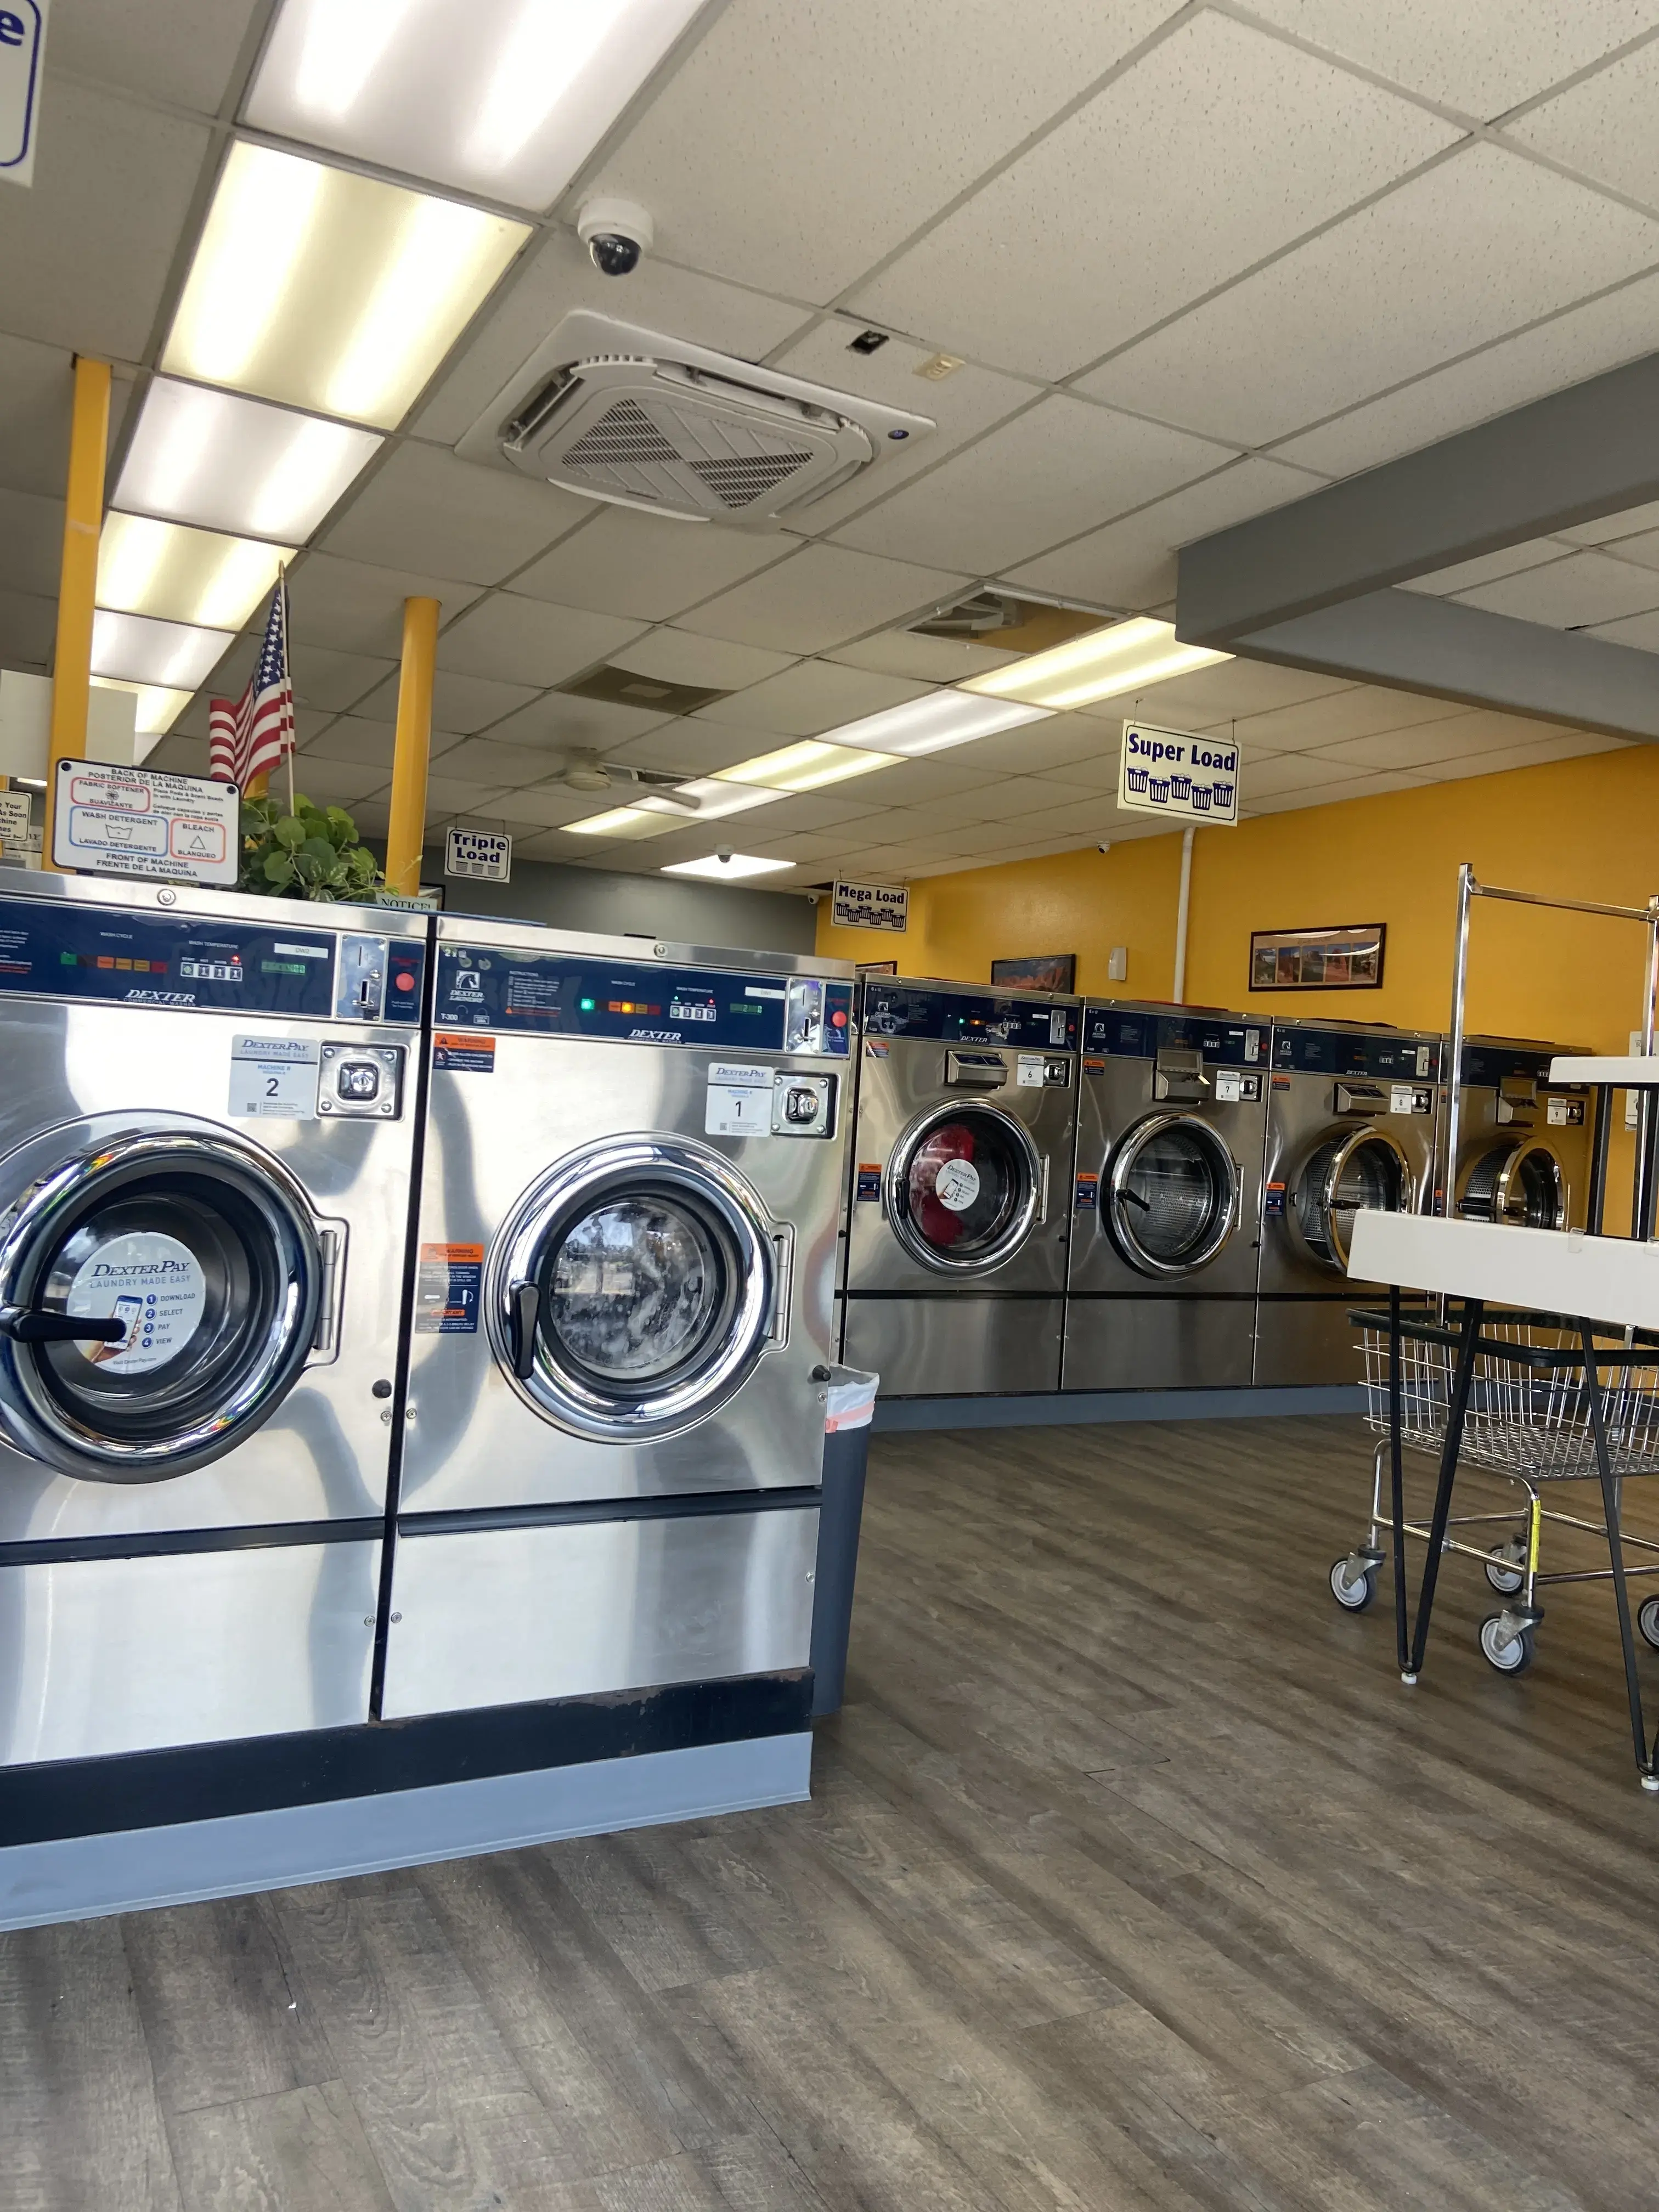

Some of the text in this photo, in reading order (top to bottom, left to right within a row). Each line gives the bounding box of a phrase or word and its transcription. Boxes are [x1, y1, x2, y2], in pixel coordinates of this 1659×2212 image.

[1128, 733, 1235, 771] Super Load
[88, 772, 137, 784] POSTERIOR
[166, 782, 203, 793] MAQUINA
[111, 769, 134, 777] BACK
[151, 774, 188, 785] MACHINE
[80, 780, 144, 794] FABRIC SOFTENER
[5, 802, 22, 810] Your
[89, 798, 133, 809] SUAVIZANTE
[82, 811, 157, 826] WASH DETERGENT
[182, 823, 215, 833] BLEACH
[79, 838, 157, 852] LAVADO DETERGENTE
[453, 833, 506, 850] Triple
[106, 853, 135, 862] FRONT
[151, 858, 189, 868] MACHINE
[178, 850, 216, 859] BLANQUEO
[456, 847, 500, 864] Load
[97, 860, 130, 870] FRENTE
[146, 865, 157, 873] LA
[159, 866, 198, 877] MAQUINA
[839, 885, 904, 904] Mega Load
[381, 898, 431, 910] NOTICE!
[125, 989, 196, 1003] DEXTER
[629, 1029, 681, 1041] DEXTER
[266, 1077, 279, 1097] 2
[735, 1101, 742, 1116] 1
[90, 1274, 191, 1288] LAUNDRY MADE EASY
[161, 1293, 195, 1302] DOWNLOAD
[159, 1308, 183, 1316] SELECT
